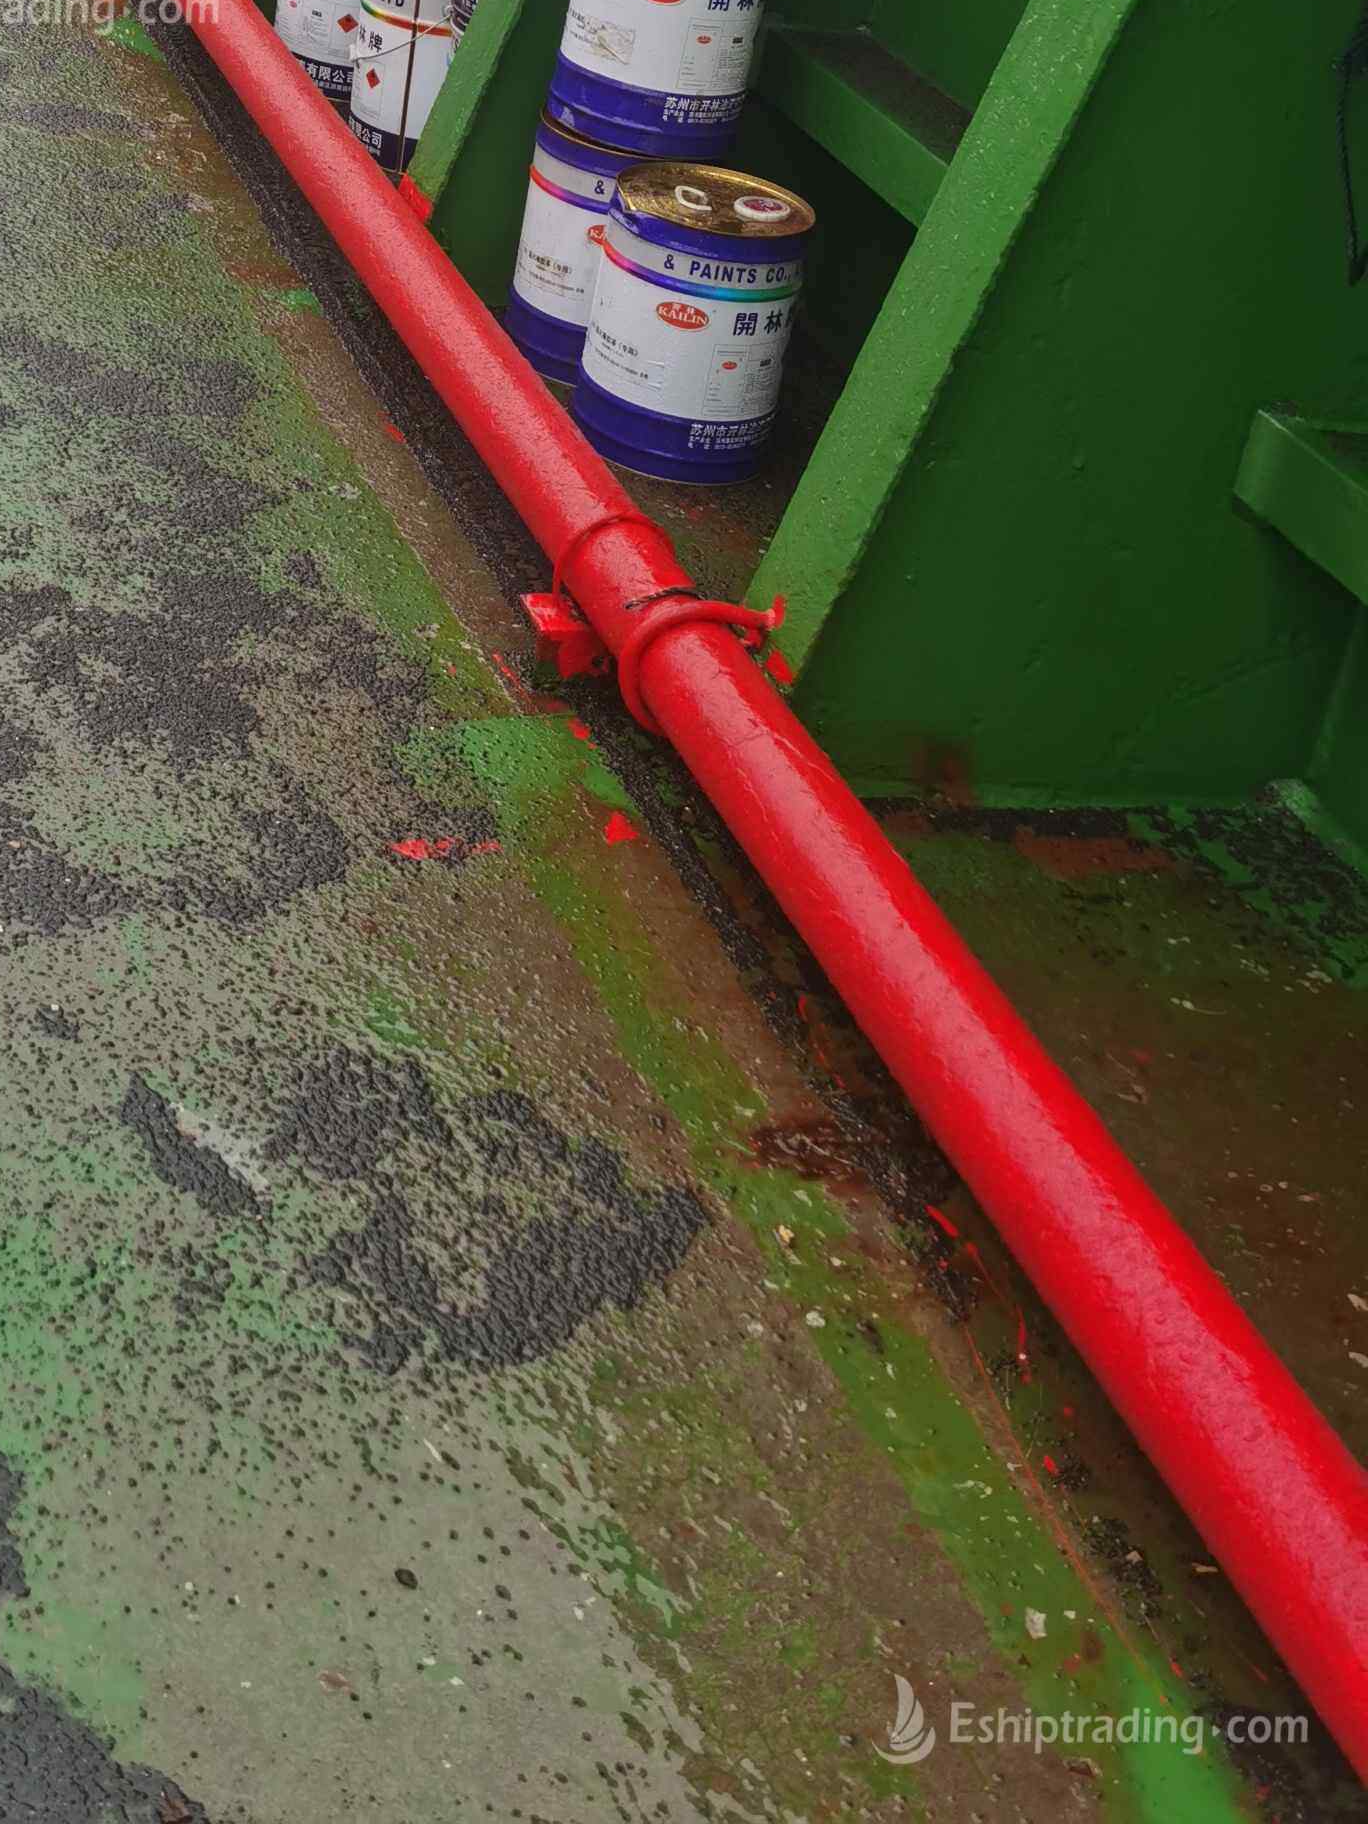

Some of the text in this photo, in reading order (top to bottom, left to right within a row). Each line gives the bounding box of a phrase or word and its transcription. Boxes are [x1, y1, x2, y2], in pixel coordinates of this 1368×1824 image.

[594, 179, 605, 195] &
[663, 253, 675, 271] &
[689, 260, 758, 284] PAINTS
[657, 305, 709, 326] KAILIN
